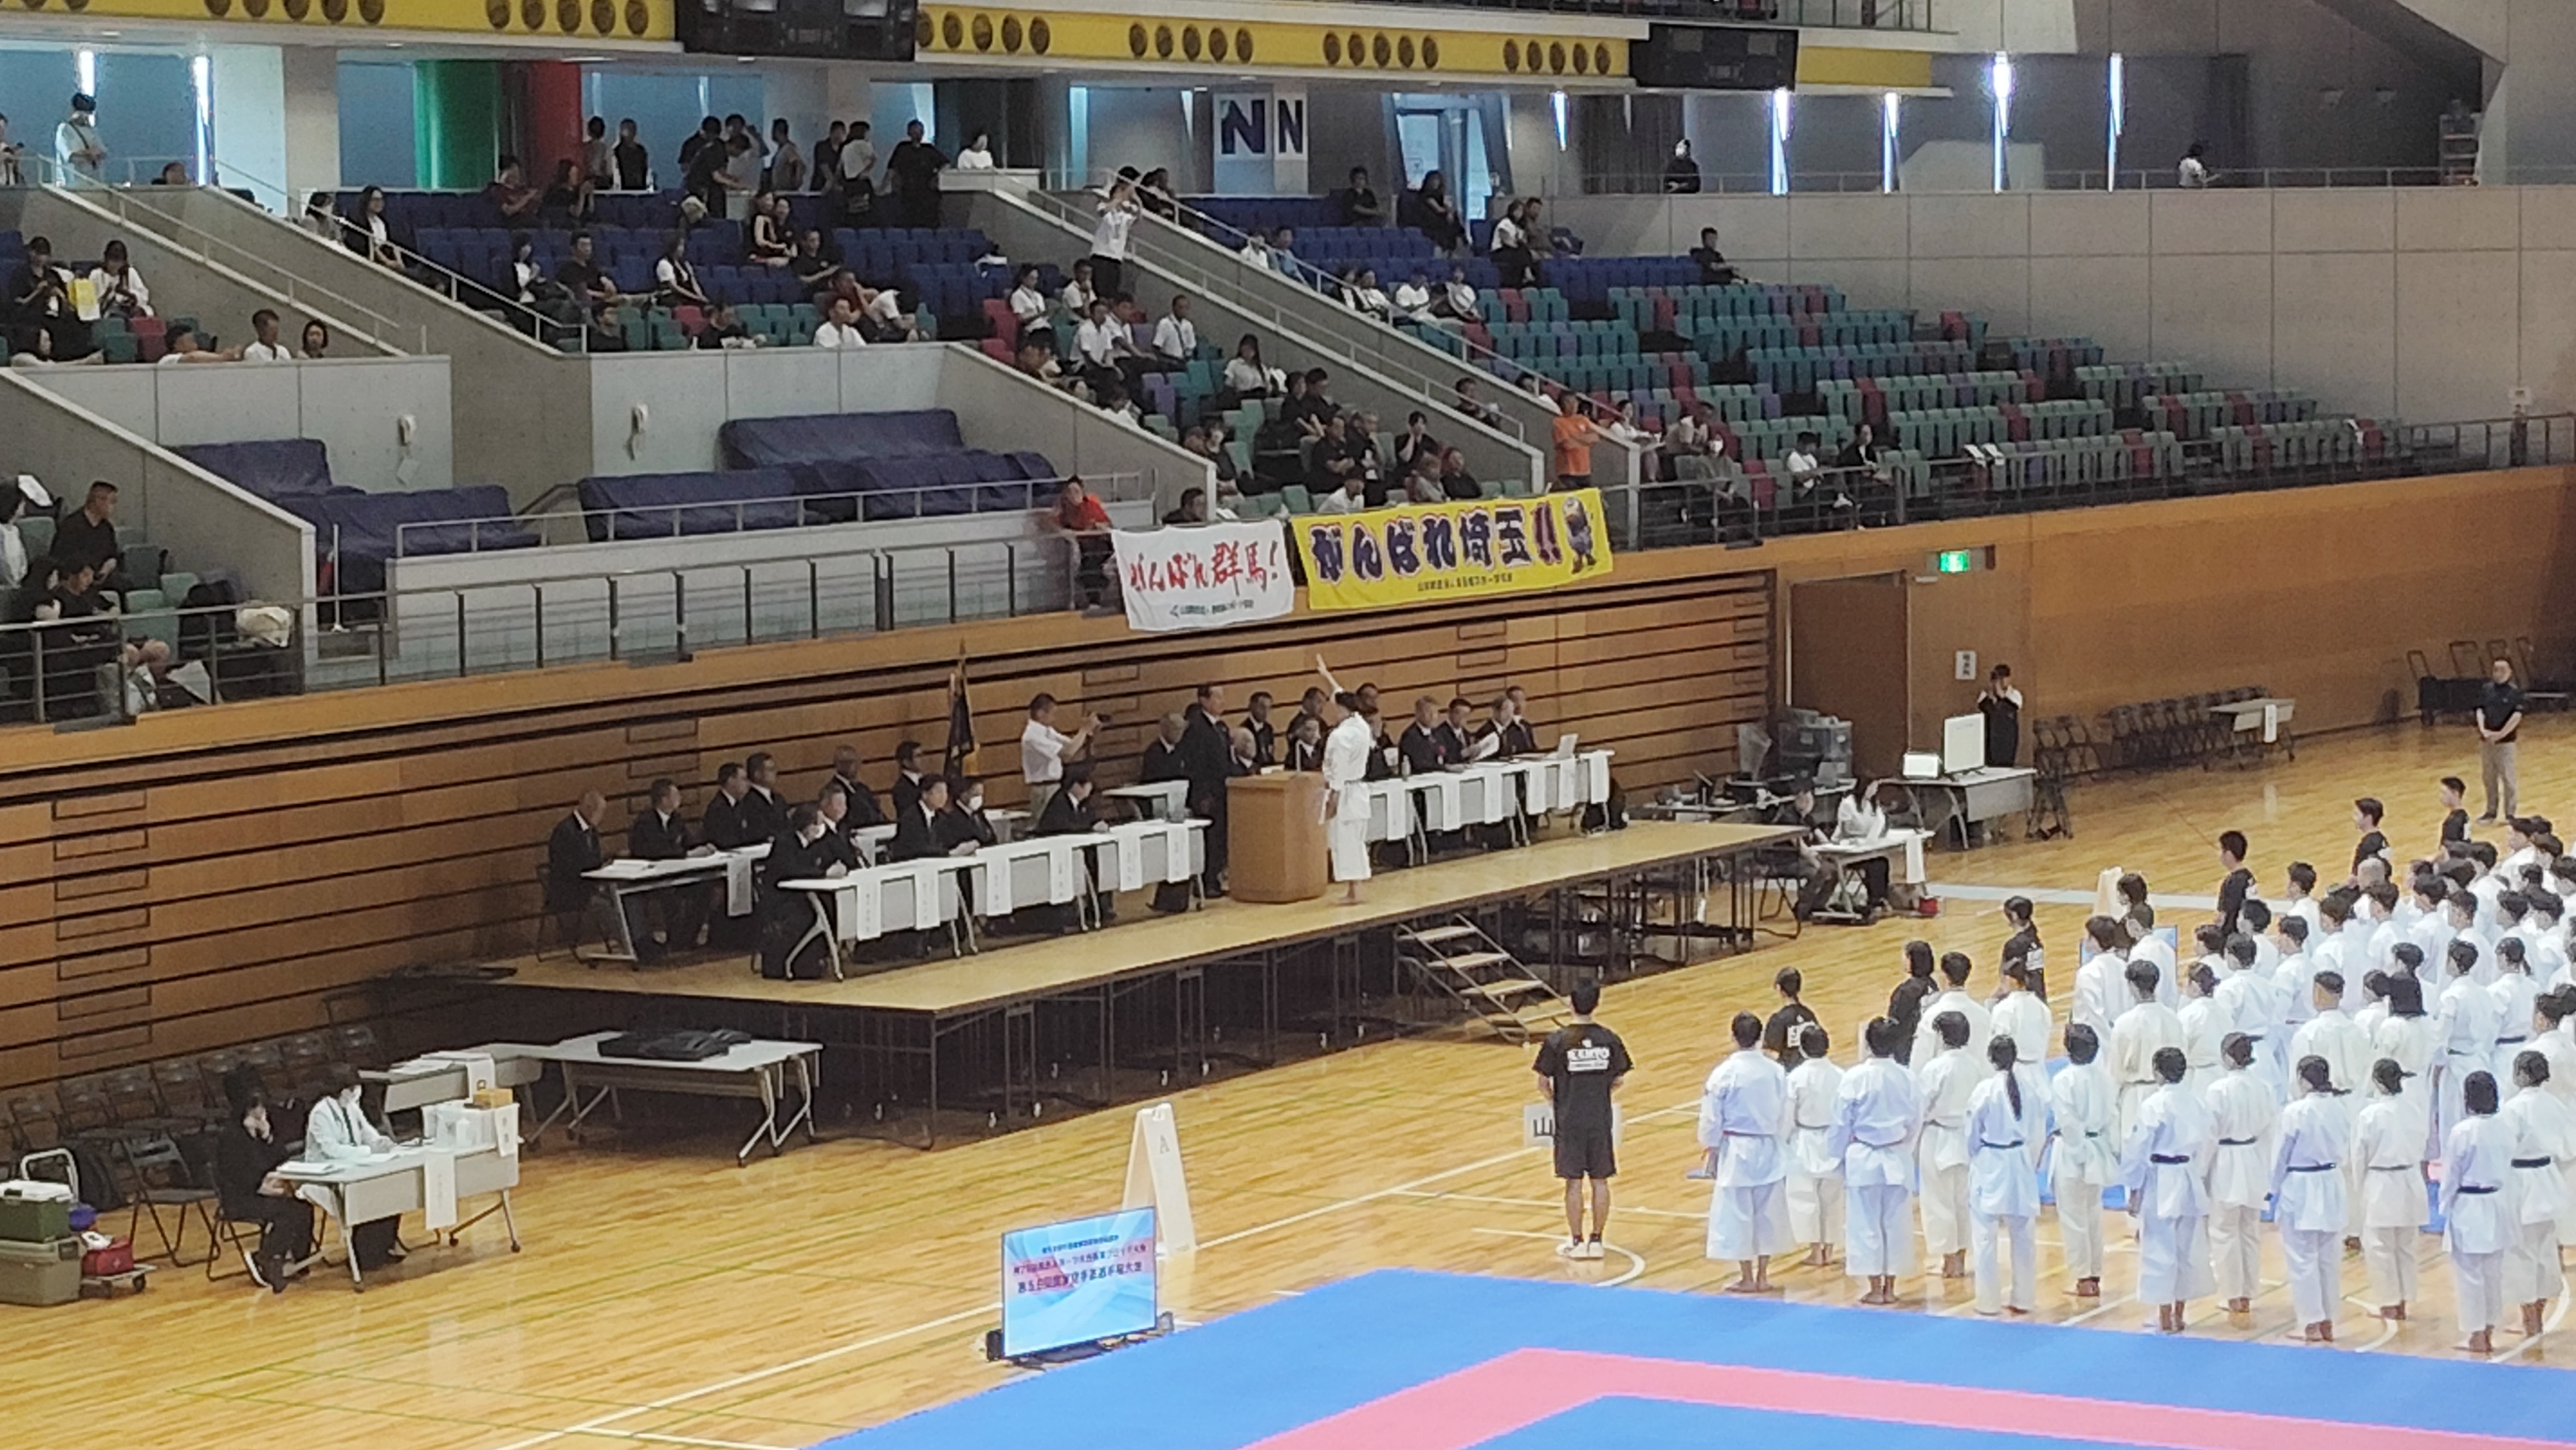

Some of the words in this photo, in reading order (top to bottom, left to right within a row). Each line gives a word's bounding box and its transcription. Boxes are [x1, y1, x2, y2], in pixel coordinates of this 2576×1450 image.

[1220, 99, 1265, 154] N
[1278, 99, 1303, 153] N
[1130, 540, 1277, 597] がんばれ群馬!
[1309, 501, 1564, 583] がんばれ埼玉!!
